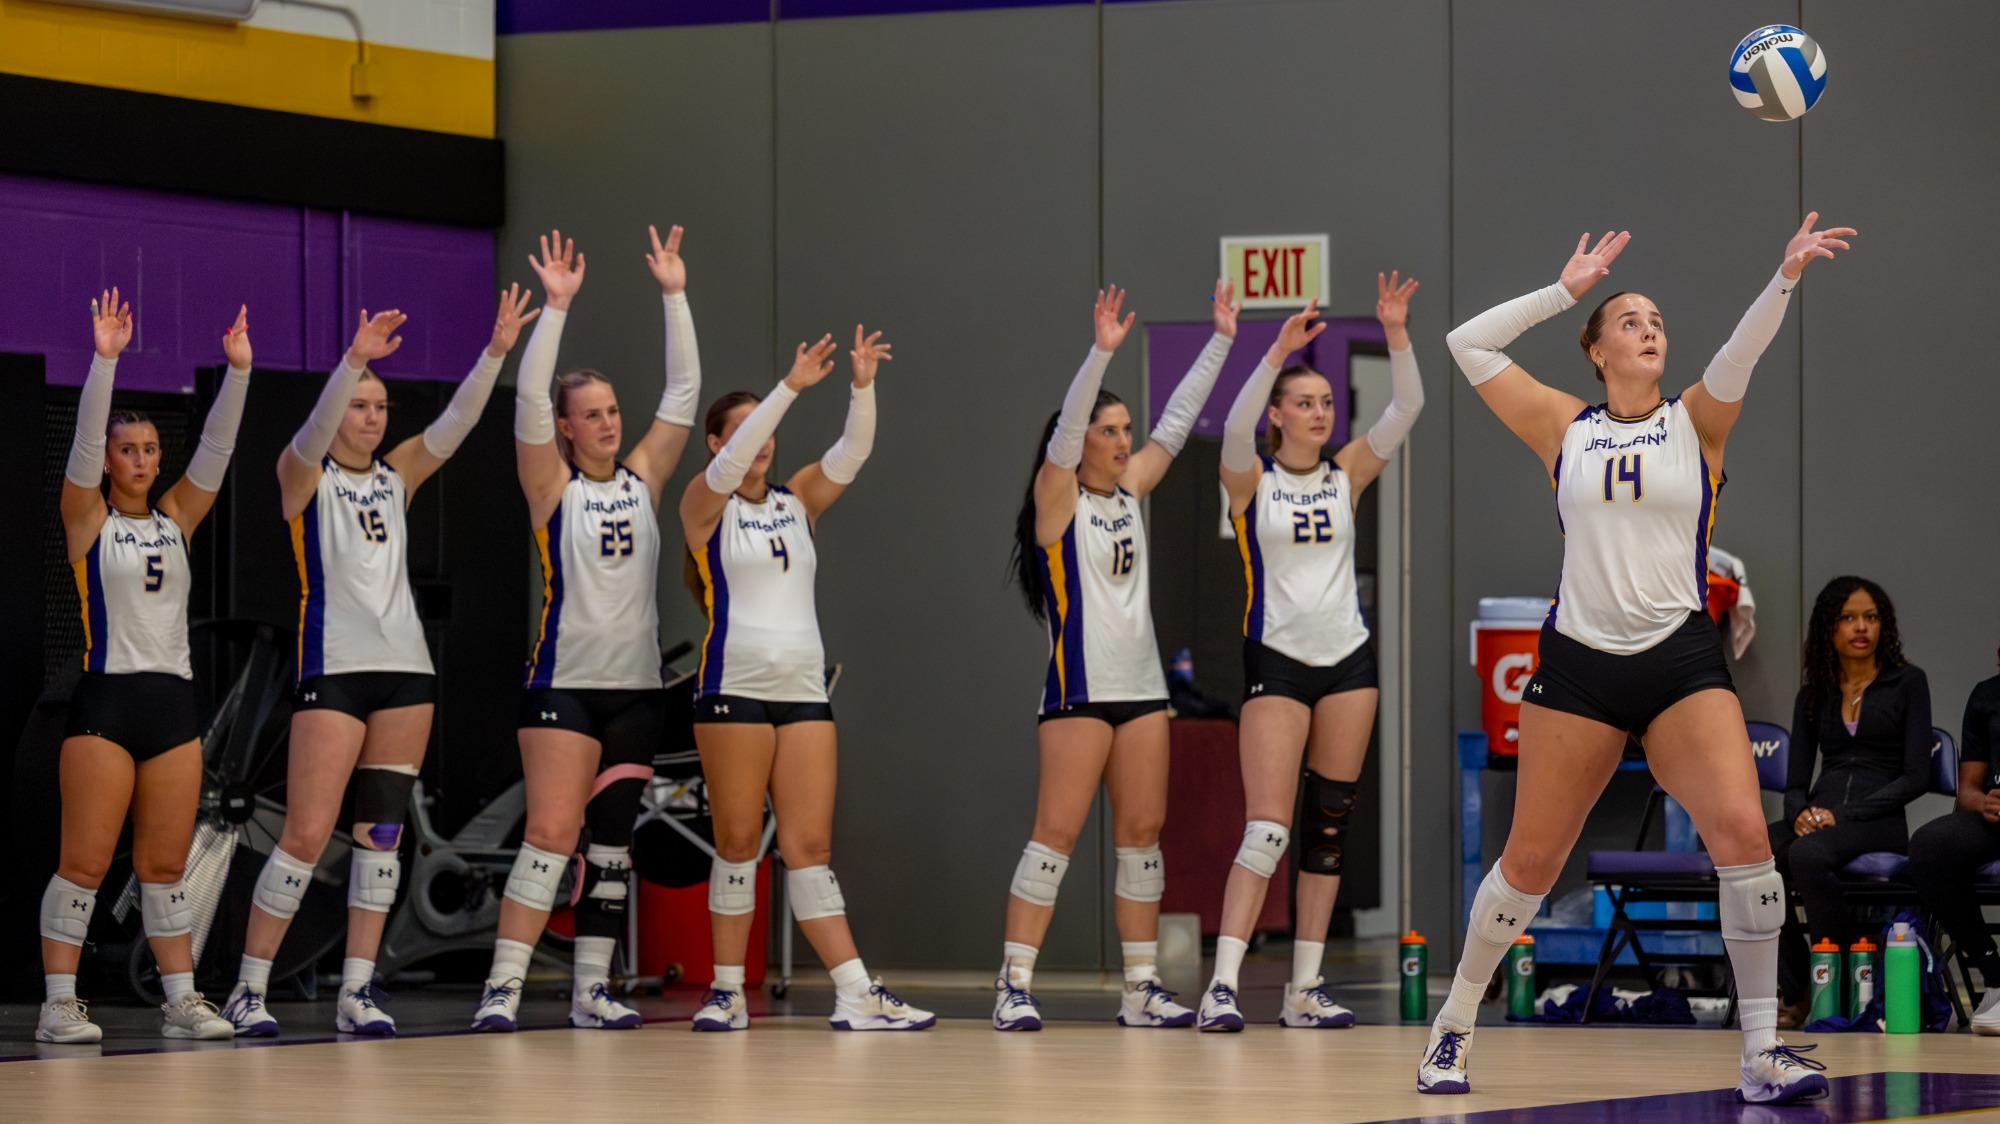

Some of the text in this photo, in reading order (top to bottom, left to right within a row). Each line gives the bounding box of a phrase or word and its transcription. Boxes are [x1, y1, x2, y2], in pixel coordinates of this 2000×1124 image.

[1743, 33, 1793, 61] molten
[1244, 247, 1305, 298] EXIT
[1602, 452, 1645, 503] 14
[1272, 488, 1338, 506] UALBANY
[358, 509, 388, 543] 15
[600, 519, 634, 556] 25
[1292, 508, 1334, 544] 22
[769, 535, 790, 574] 4
[1111, 537, 1134, 576] 16
[144, 554, 164, 593] 5
[1493, 653, 1533, 704] G
[1402, 957, 1420, 976] G
[1516, 956, 1533, 976] G
[1813, 964, 1829, 984] G
